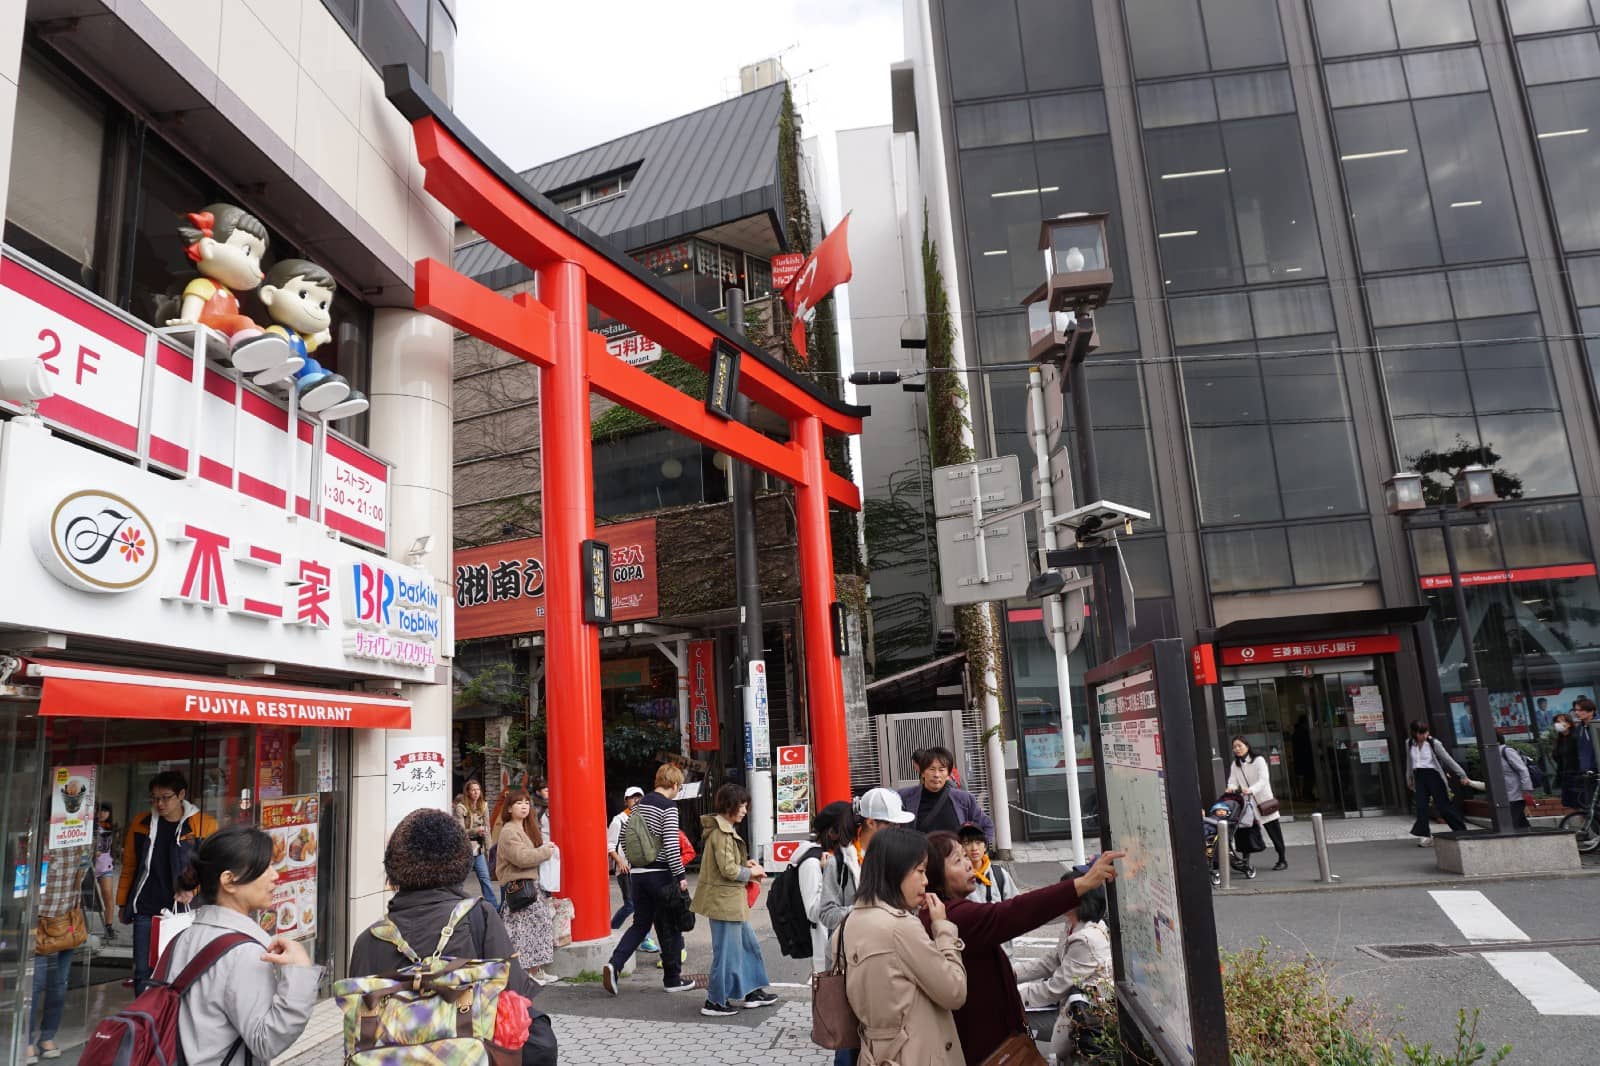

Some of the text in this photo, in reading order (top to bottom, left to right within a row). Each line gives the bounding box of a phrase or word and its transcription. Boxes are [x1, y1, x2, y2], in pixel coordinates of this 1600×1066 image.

[37, 328, 101, 386] 2F
[336, 464, 373, 494] レストラン
[180, 524, 331, 626] 不二家
[399, 610, 438, 638] robbins
[356, 632, 435, 665] サーティワン アイスクリーム
[1272, 641, 1356, 658] 三菱東京UFJ銀行
[185, 695, 353, 721] FUJIYA RESTAURANT
[392, 780, 446, 794] フレッシュサンド
